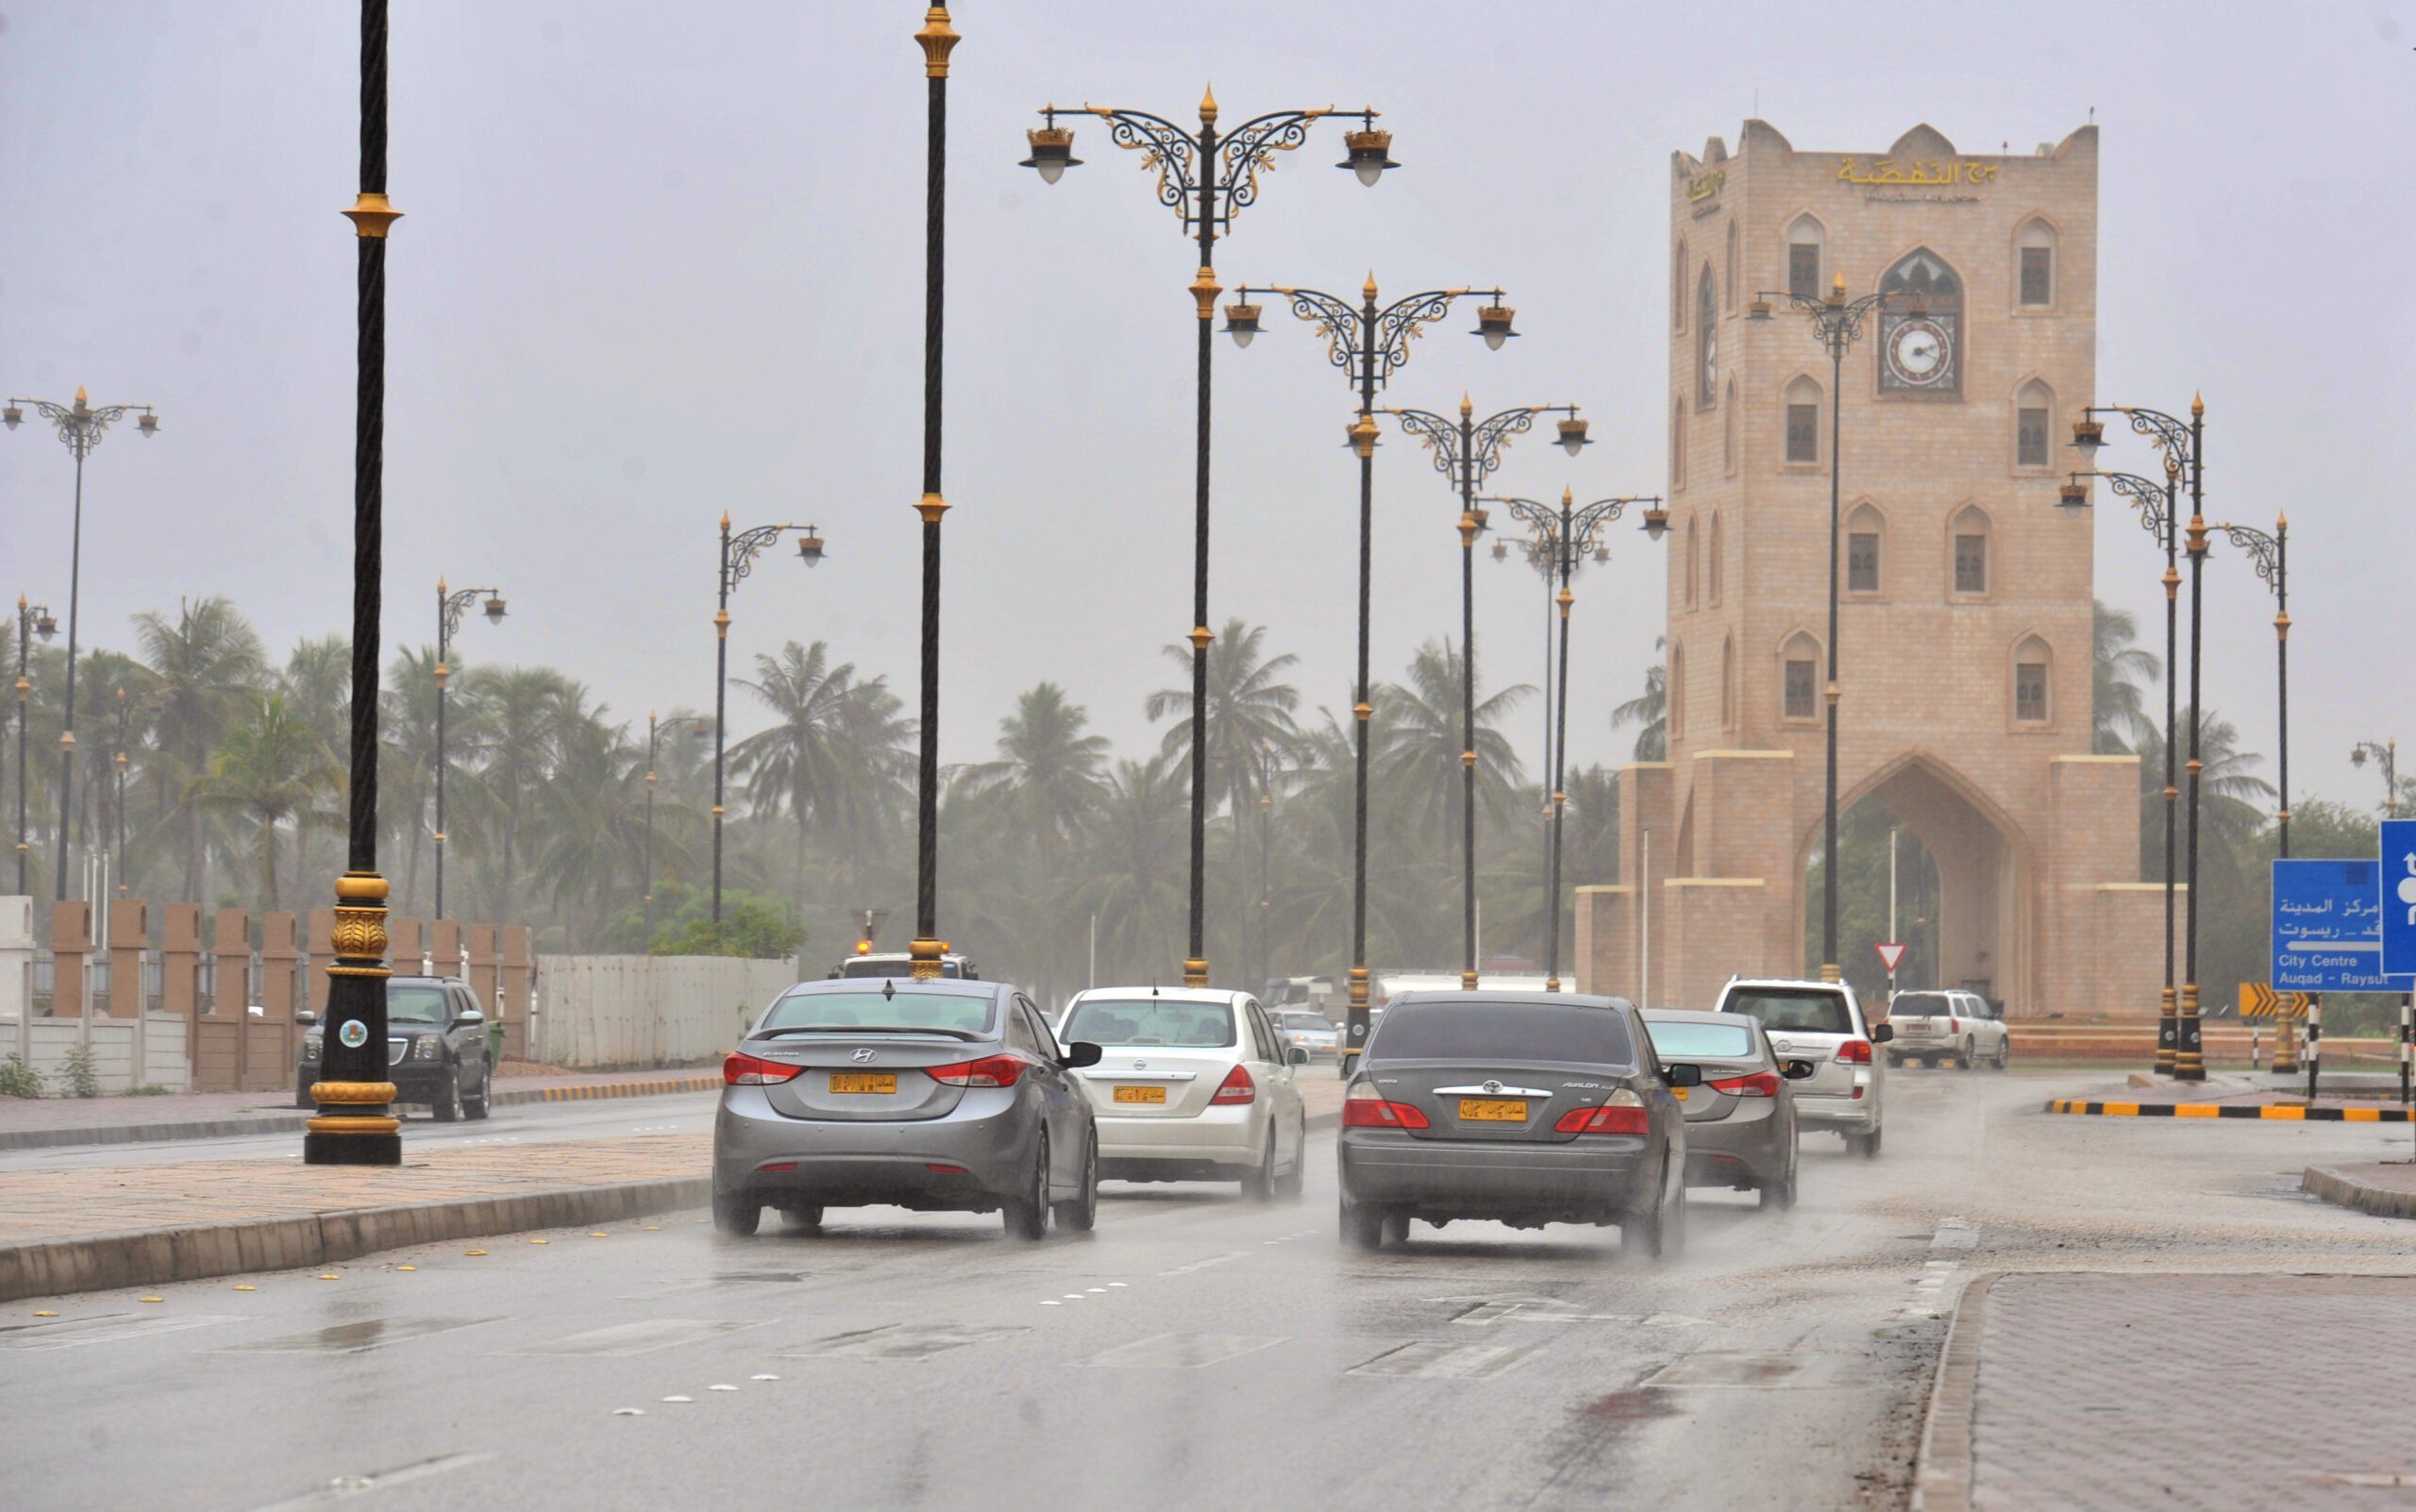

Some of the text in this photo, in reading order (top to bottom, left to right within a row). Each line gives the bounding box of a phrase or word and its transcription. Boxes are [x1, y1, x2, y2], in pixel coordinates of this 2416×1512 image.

[1962, 161, 1999, 184] برج
[2280, 899, 2379, 916] مركز المدينة
[2278, 923, 2340, 938] ريسوت
[2278, 954, 2357, 968] City Centre
[2279, 972, 2323, 985] Auqad
[2341, 972, 2389, 986] Raysut
